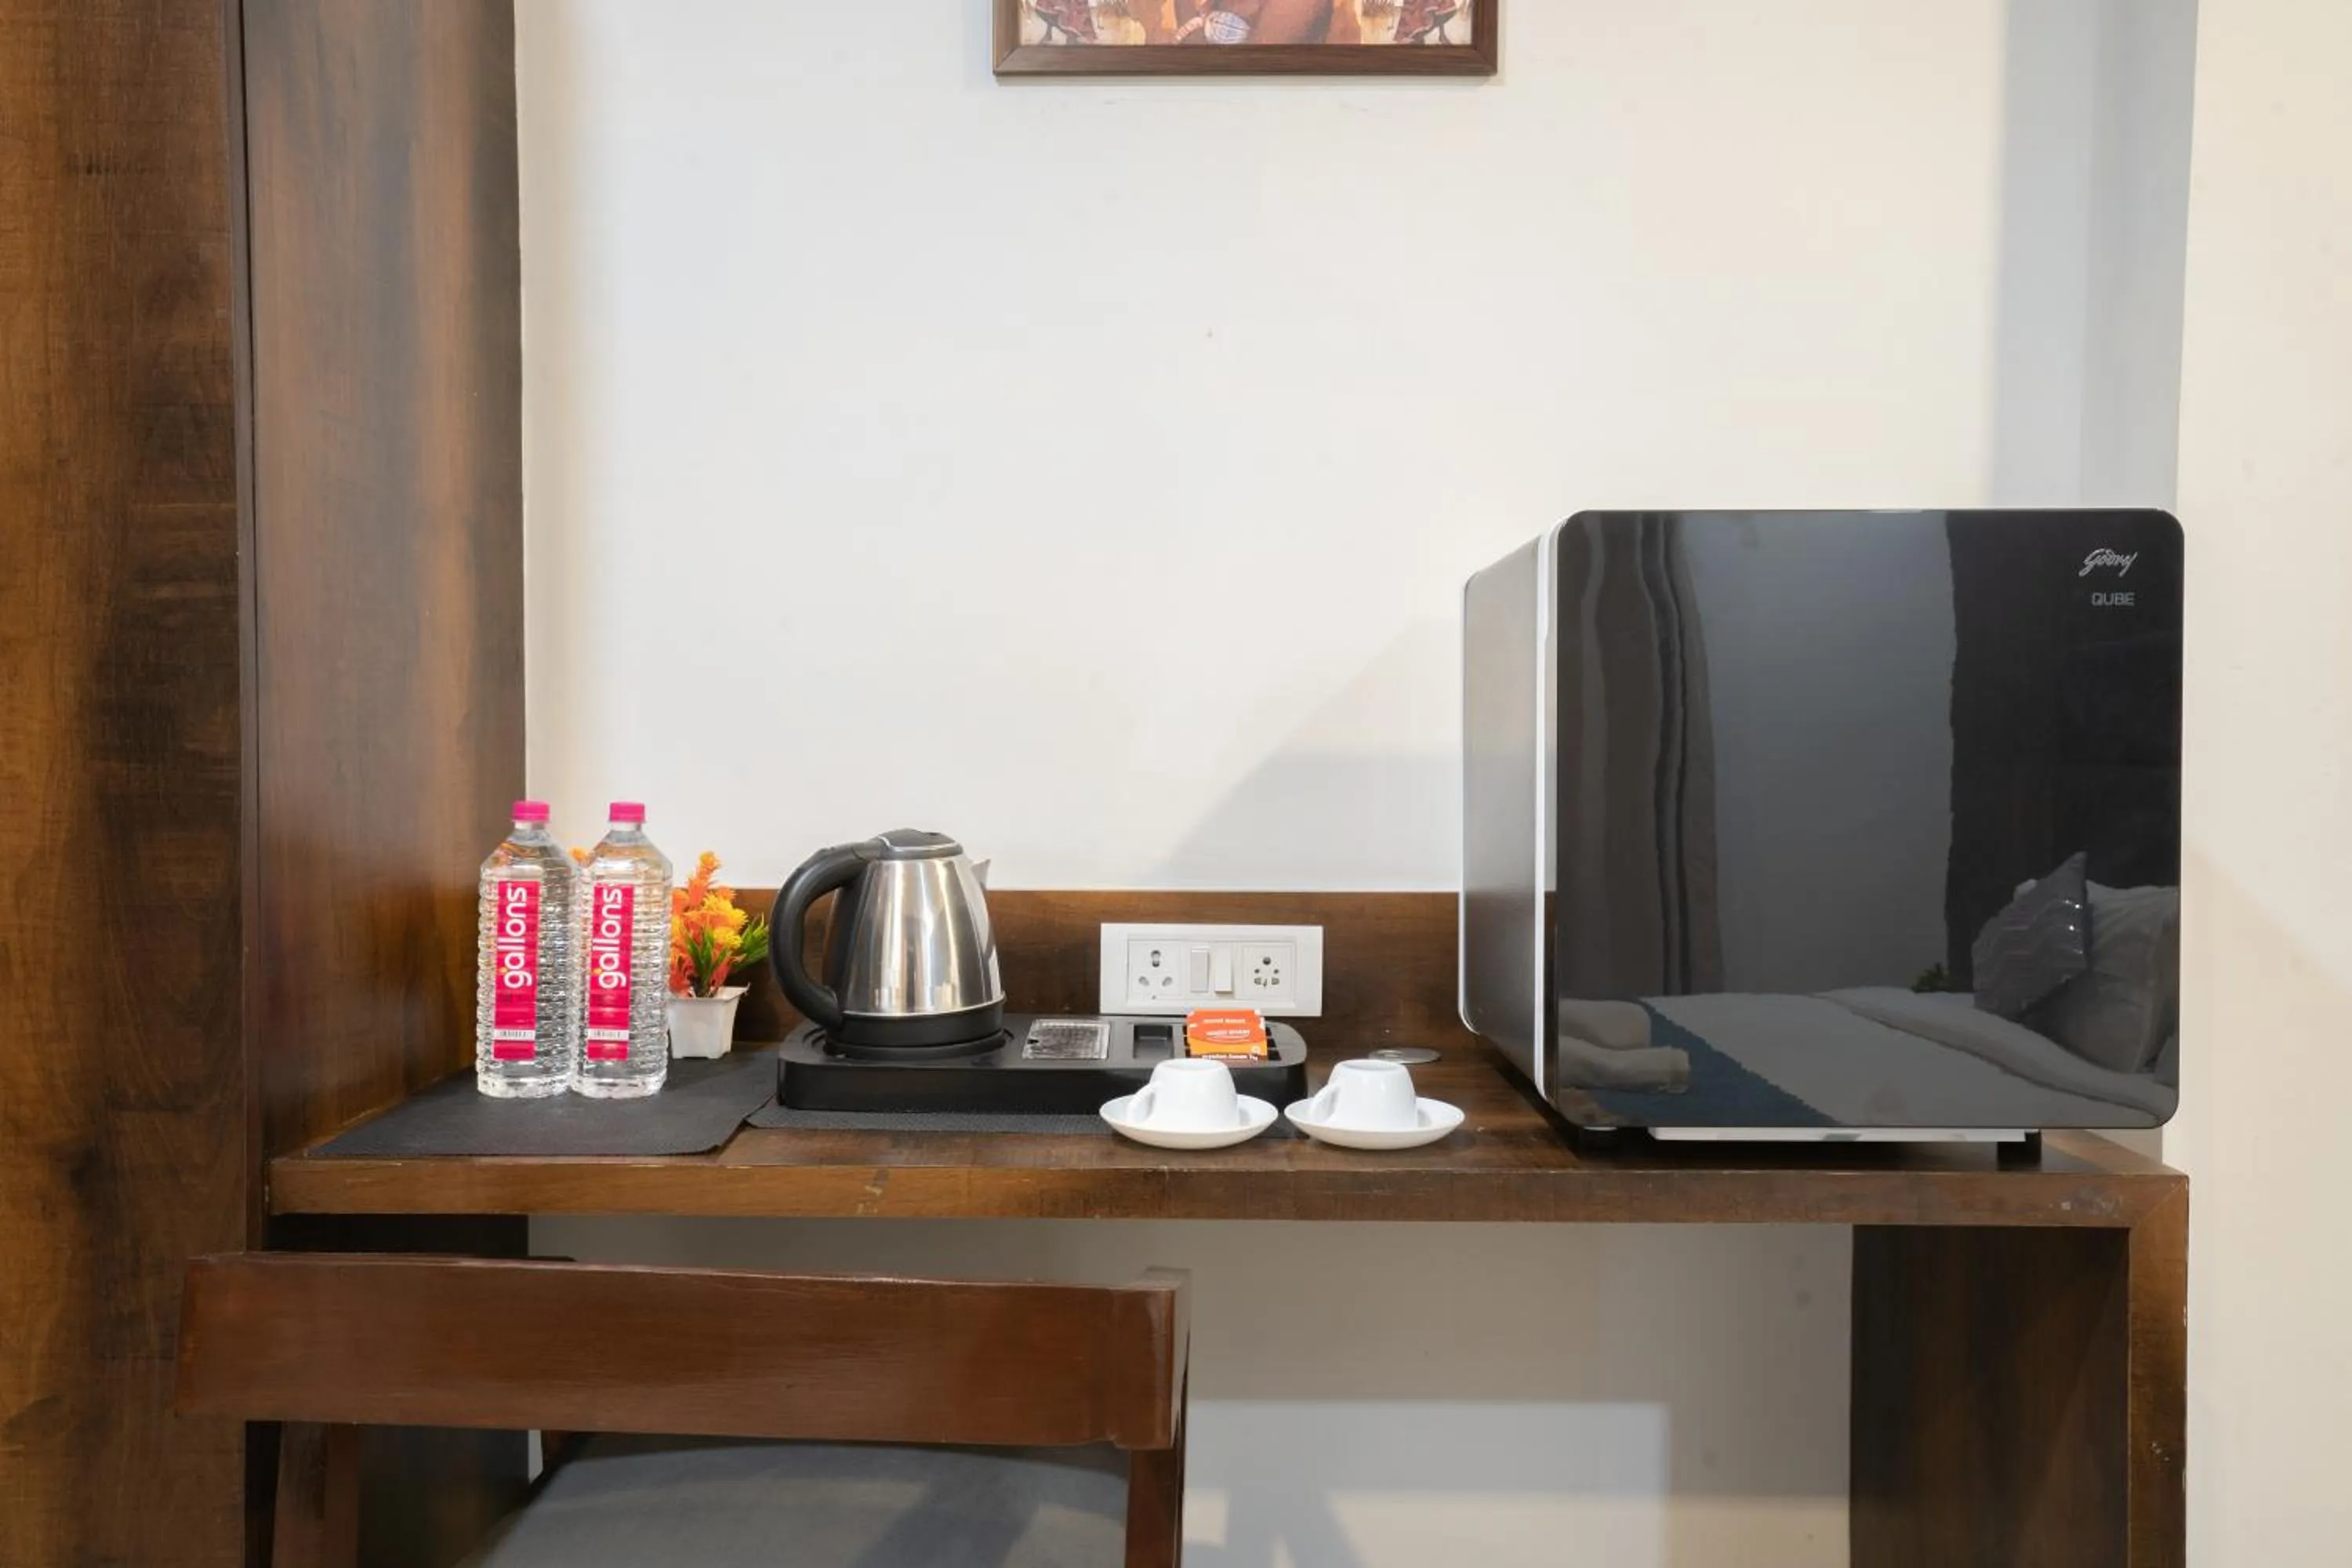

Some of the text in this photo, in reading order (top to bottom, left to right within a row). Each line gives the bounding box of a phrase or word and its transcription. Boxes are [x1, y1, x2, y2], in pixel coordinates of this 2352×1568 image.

[2092, 592, 2136, 607] QUBE
[497, 887, 532, 989] gallons
[593, 887, 626, 989] gallons
